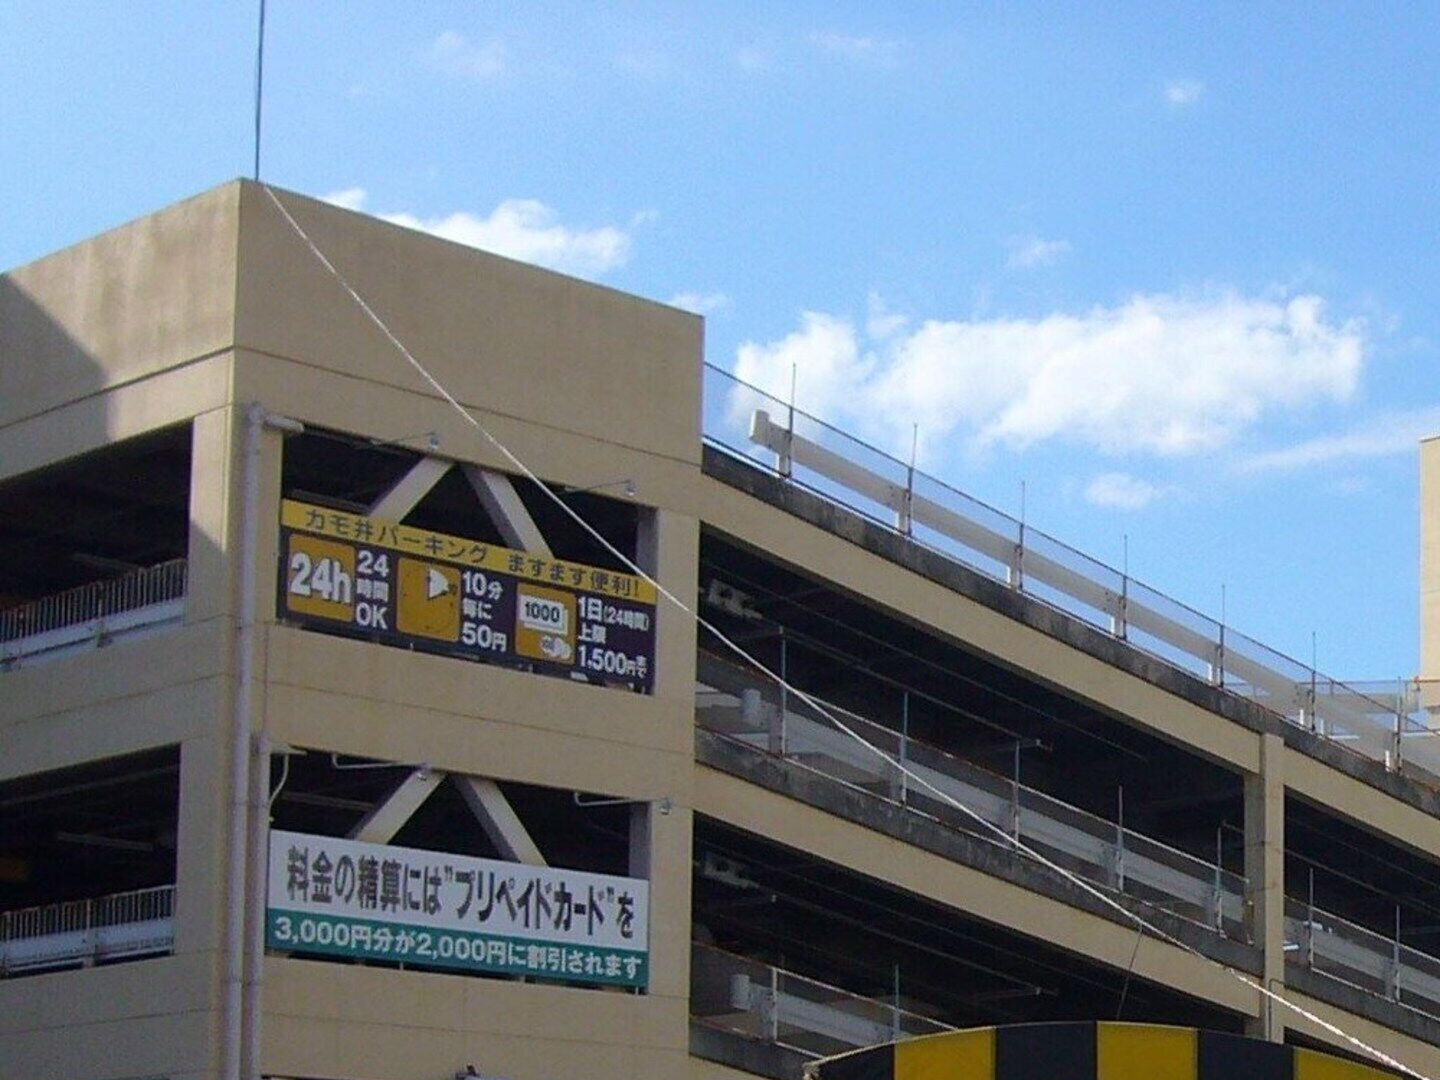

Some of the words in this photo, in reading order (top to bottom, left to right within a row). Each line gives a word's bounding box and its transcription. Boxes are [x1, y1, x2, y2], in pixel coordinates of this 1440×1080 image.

[305, 509, 491, 562] カモ井パーキング
[290, 551, 352, 604] 24h
[356, 549, 391, 578] 24
[356, 579, 391, 603] 時間
[463, 572, 504, 600] 10分
[355, 606, 388, 630] OK
[463, 598, 493, 620] 毎に
[524, 600, 561, 623] 1000
[462, 625, 507, 653] 50円
[577, 621, 607, 645] 上限
[275, 916, 643, 980] 3,000円分が2,000円に割引されます
